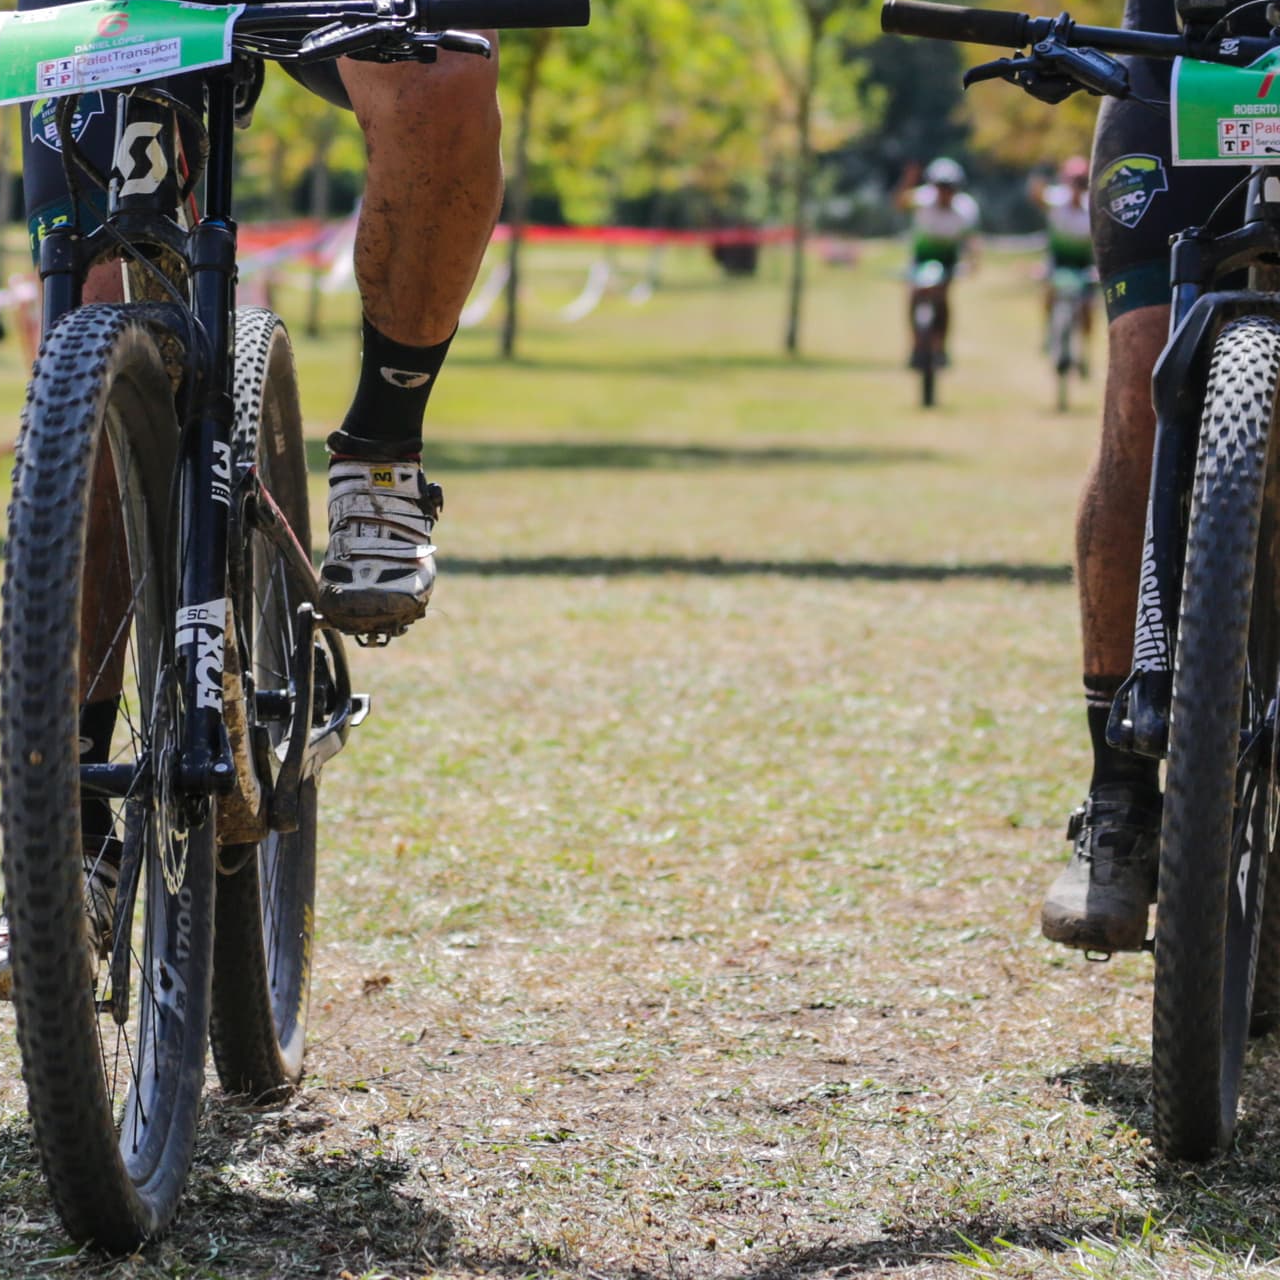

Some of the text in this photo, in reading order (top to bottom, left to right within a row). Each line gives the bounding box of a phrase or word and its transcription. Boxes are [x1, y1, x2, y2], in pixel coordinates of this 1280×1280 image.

[97, 13, 130, 38] 6
[1233, 104, 1278, 115] ROBERTO
[1109, 190, 1146, 213] EPIC
[187, 608, 209, 621] SC
[195, 627, 225, 714] FOX
